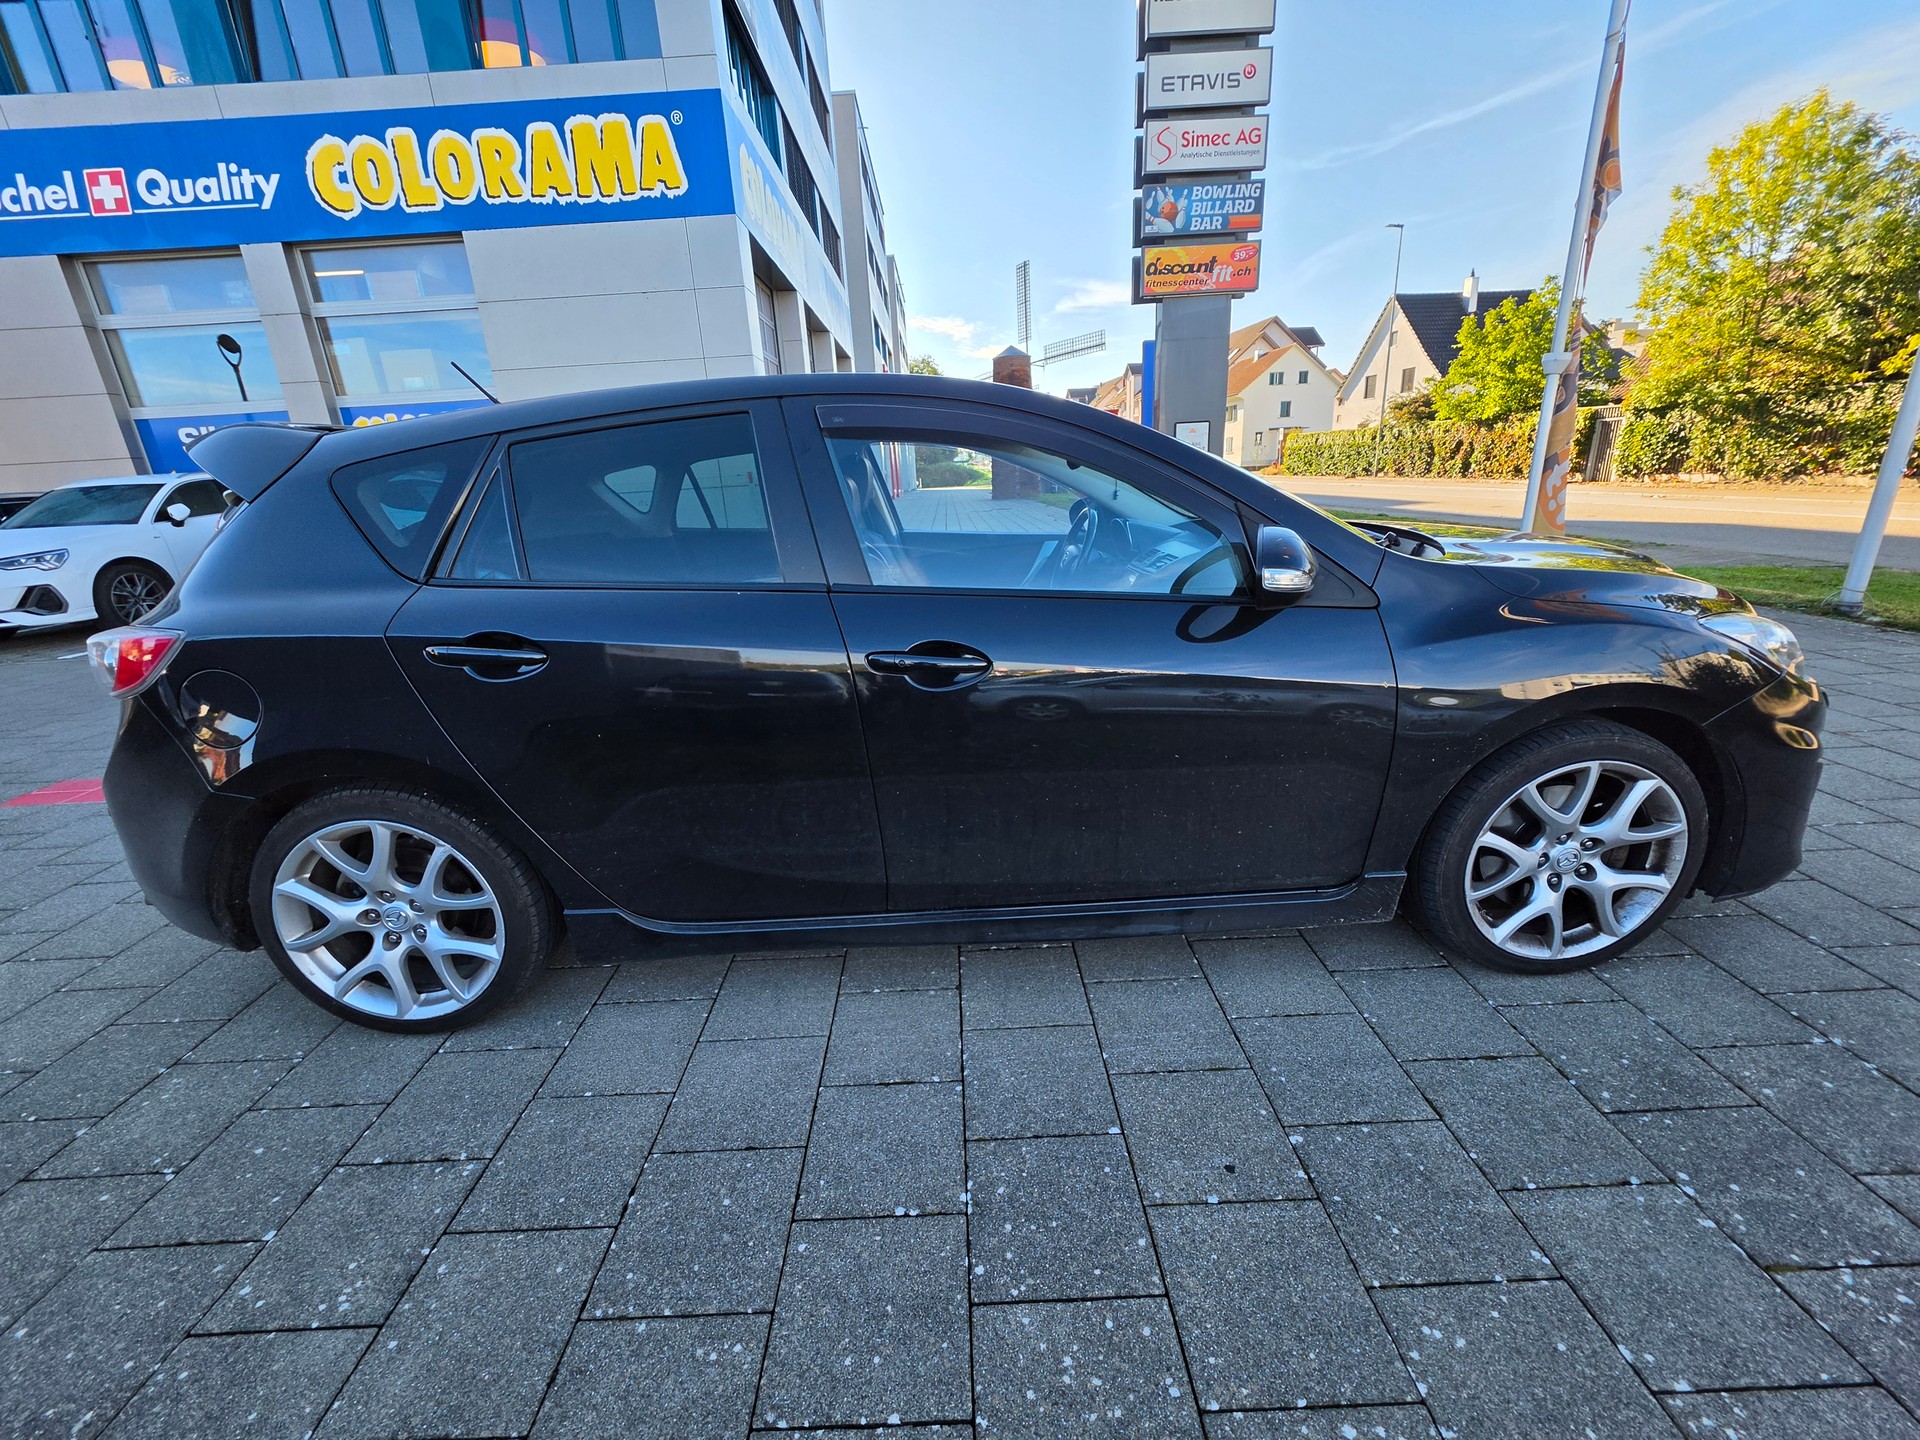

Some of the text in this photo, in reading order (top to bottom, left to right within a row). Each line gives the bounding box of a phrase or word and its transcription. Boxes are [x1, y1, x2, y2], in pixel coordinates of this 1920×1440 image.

[1161, 72, 1241, 92] ETAVIS
[1181, 127, 1262, 148] Simec AG
[1180, 149, 1261, 159] Analytische Dienstleistungen
[307, 114, 688, 219] COLORAMA
[0, 162, 281, 213] chel Quality
[1191, 183, 1262, 200] BOWLING
[1190, 199, 1256, 216] BILLARD
[1190, 216, 1223, 231] BAR
[1145, 278, 1210, 288] fitnesscenter
